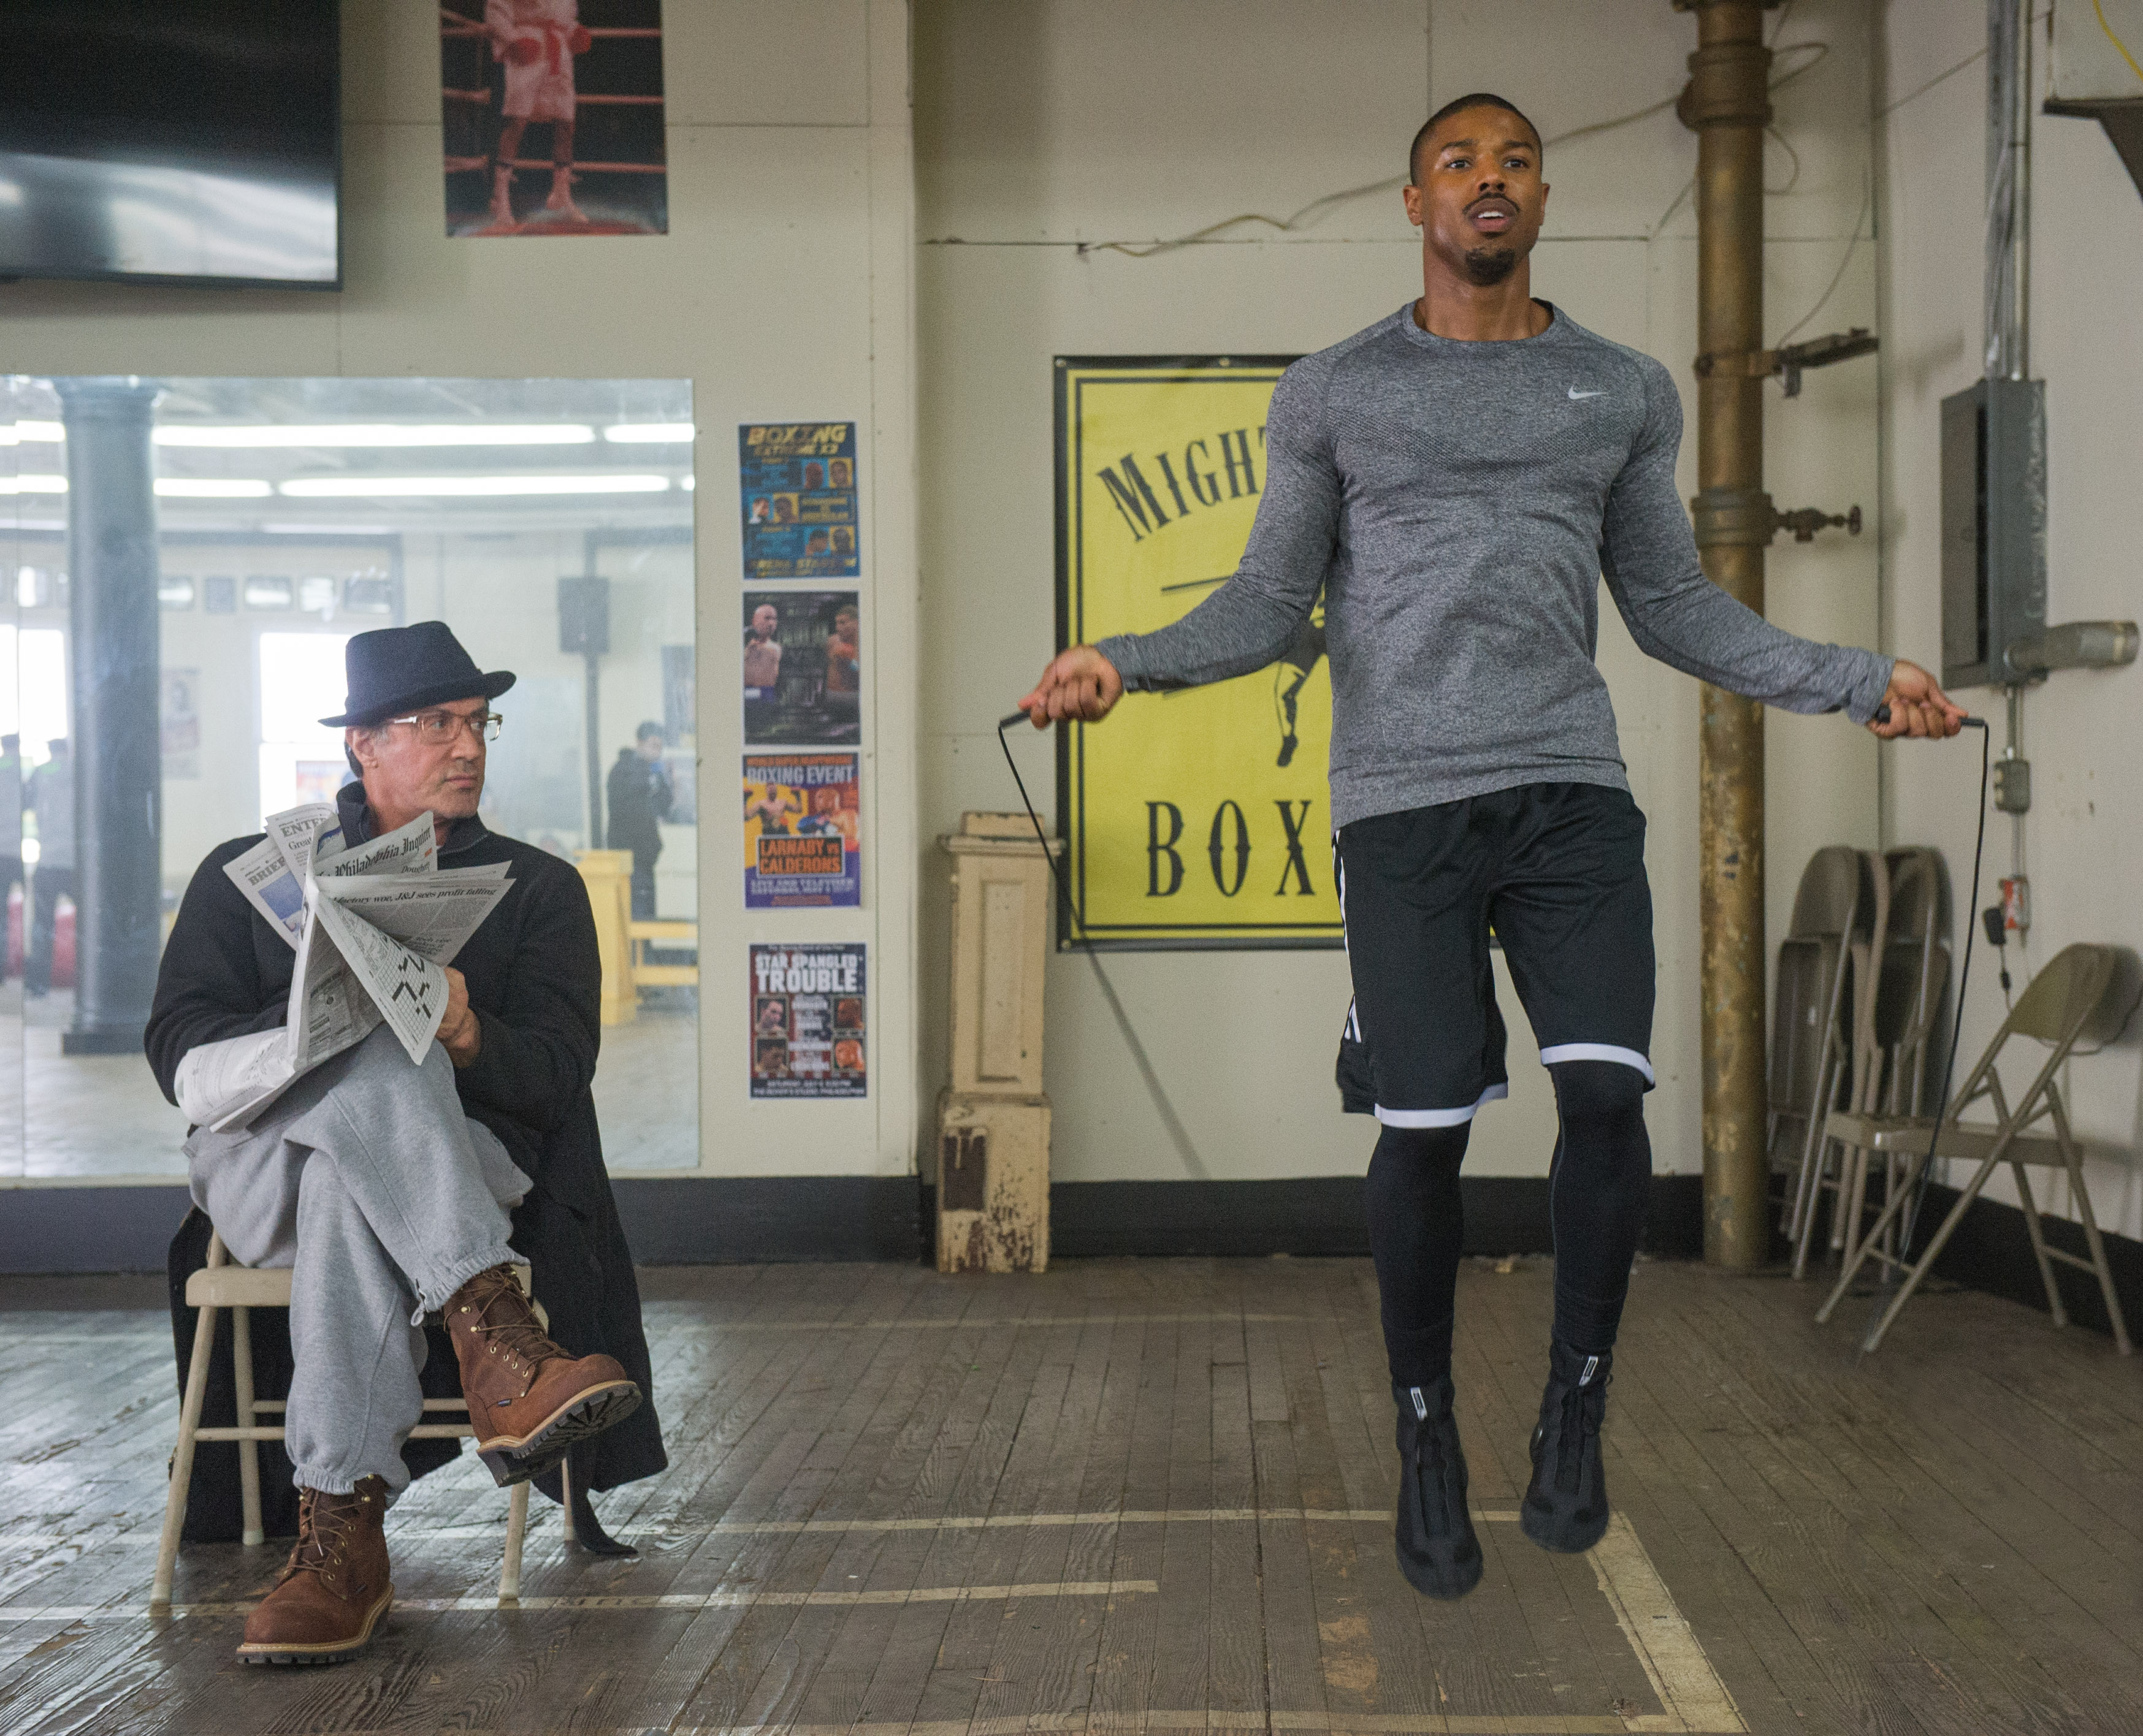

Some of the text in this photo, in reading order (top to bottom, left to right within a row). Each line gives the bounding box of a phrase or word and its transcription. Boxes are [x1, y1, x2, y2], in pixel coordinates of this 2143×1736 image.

[748, 425, 847, 445] BOXING
[1097, 425, 1266, 542] MIGH
[746, 766, 854, 784] BOXING EVENT
[1144, 800, 1315, 897] BOX
[395, 891, 416, 900] J&J
[437, 889, 465, 899] profit
[757, 969, 858, 993] TROUBLE
